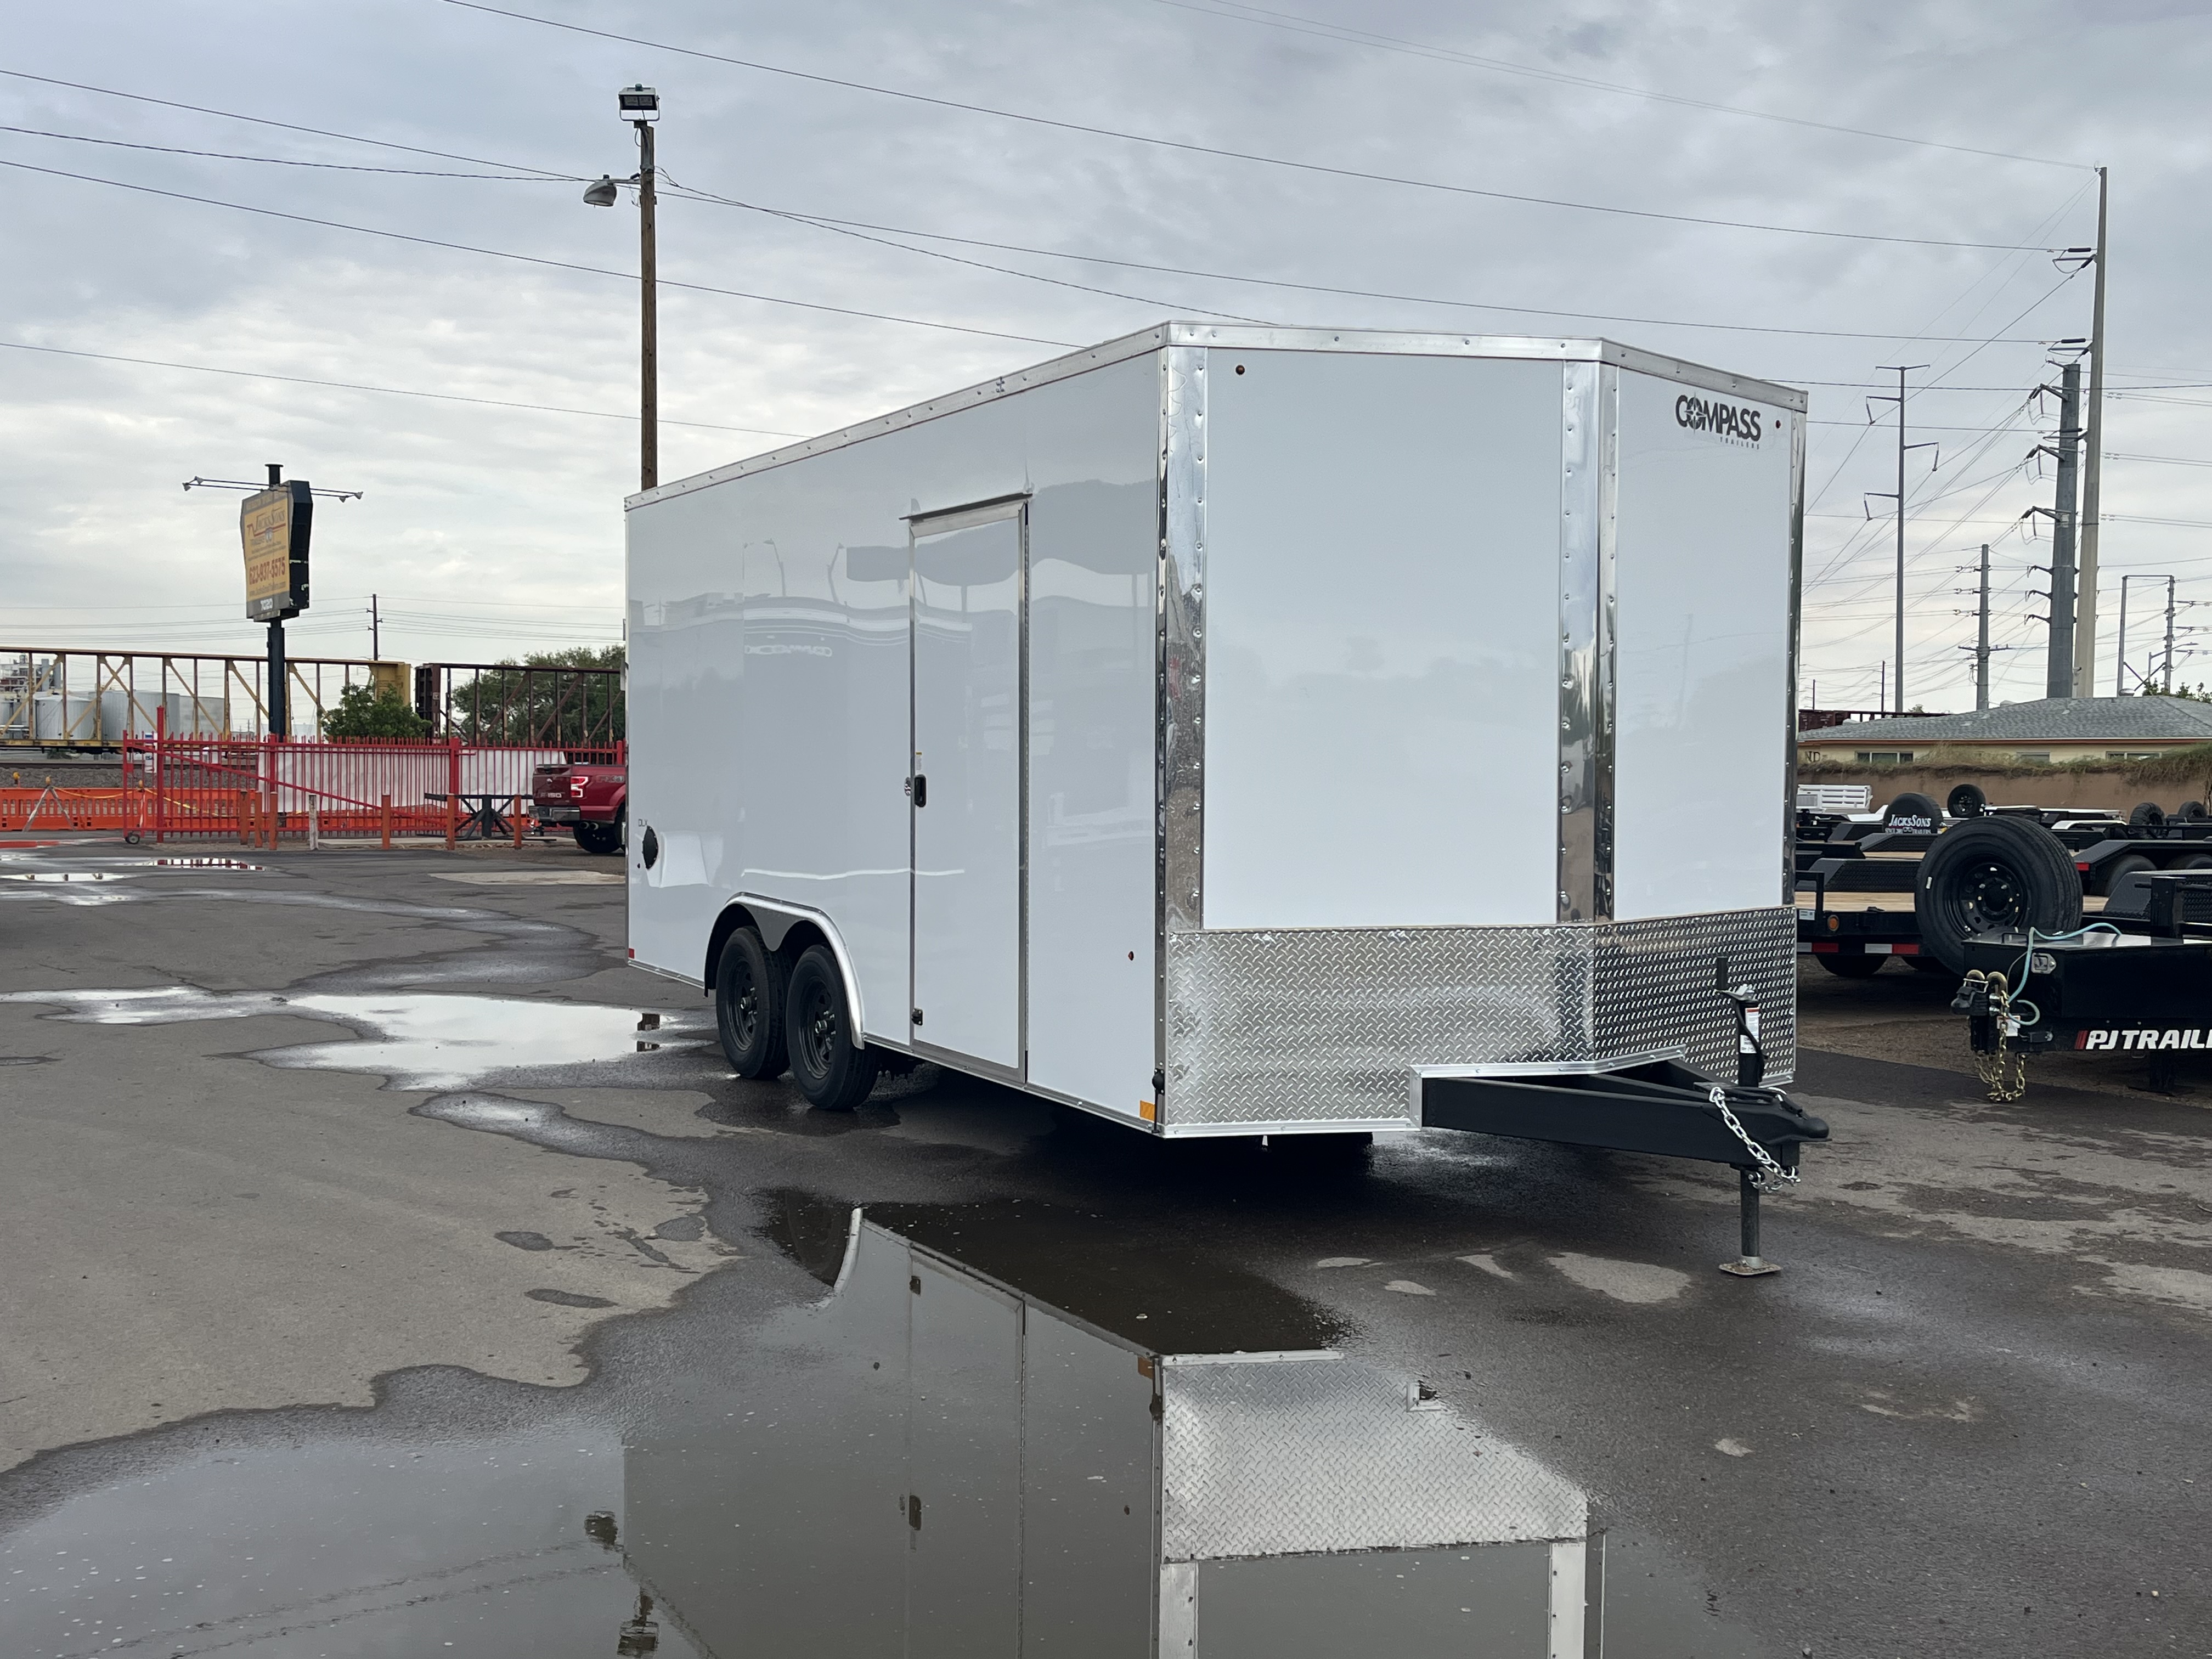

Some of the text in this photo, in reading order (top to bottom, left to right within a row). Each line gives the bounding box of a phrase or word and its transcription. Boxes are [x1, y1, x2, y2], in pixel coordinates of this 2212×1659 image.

[1675, 394, 1761, 441] COMPASS
[2086, 1029, 2212, 1049] PJ TRAIL
